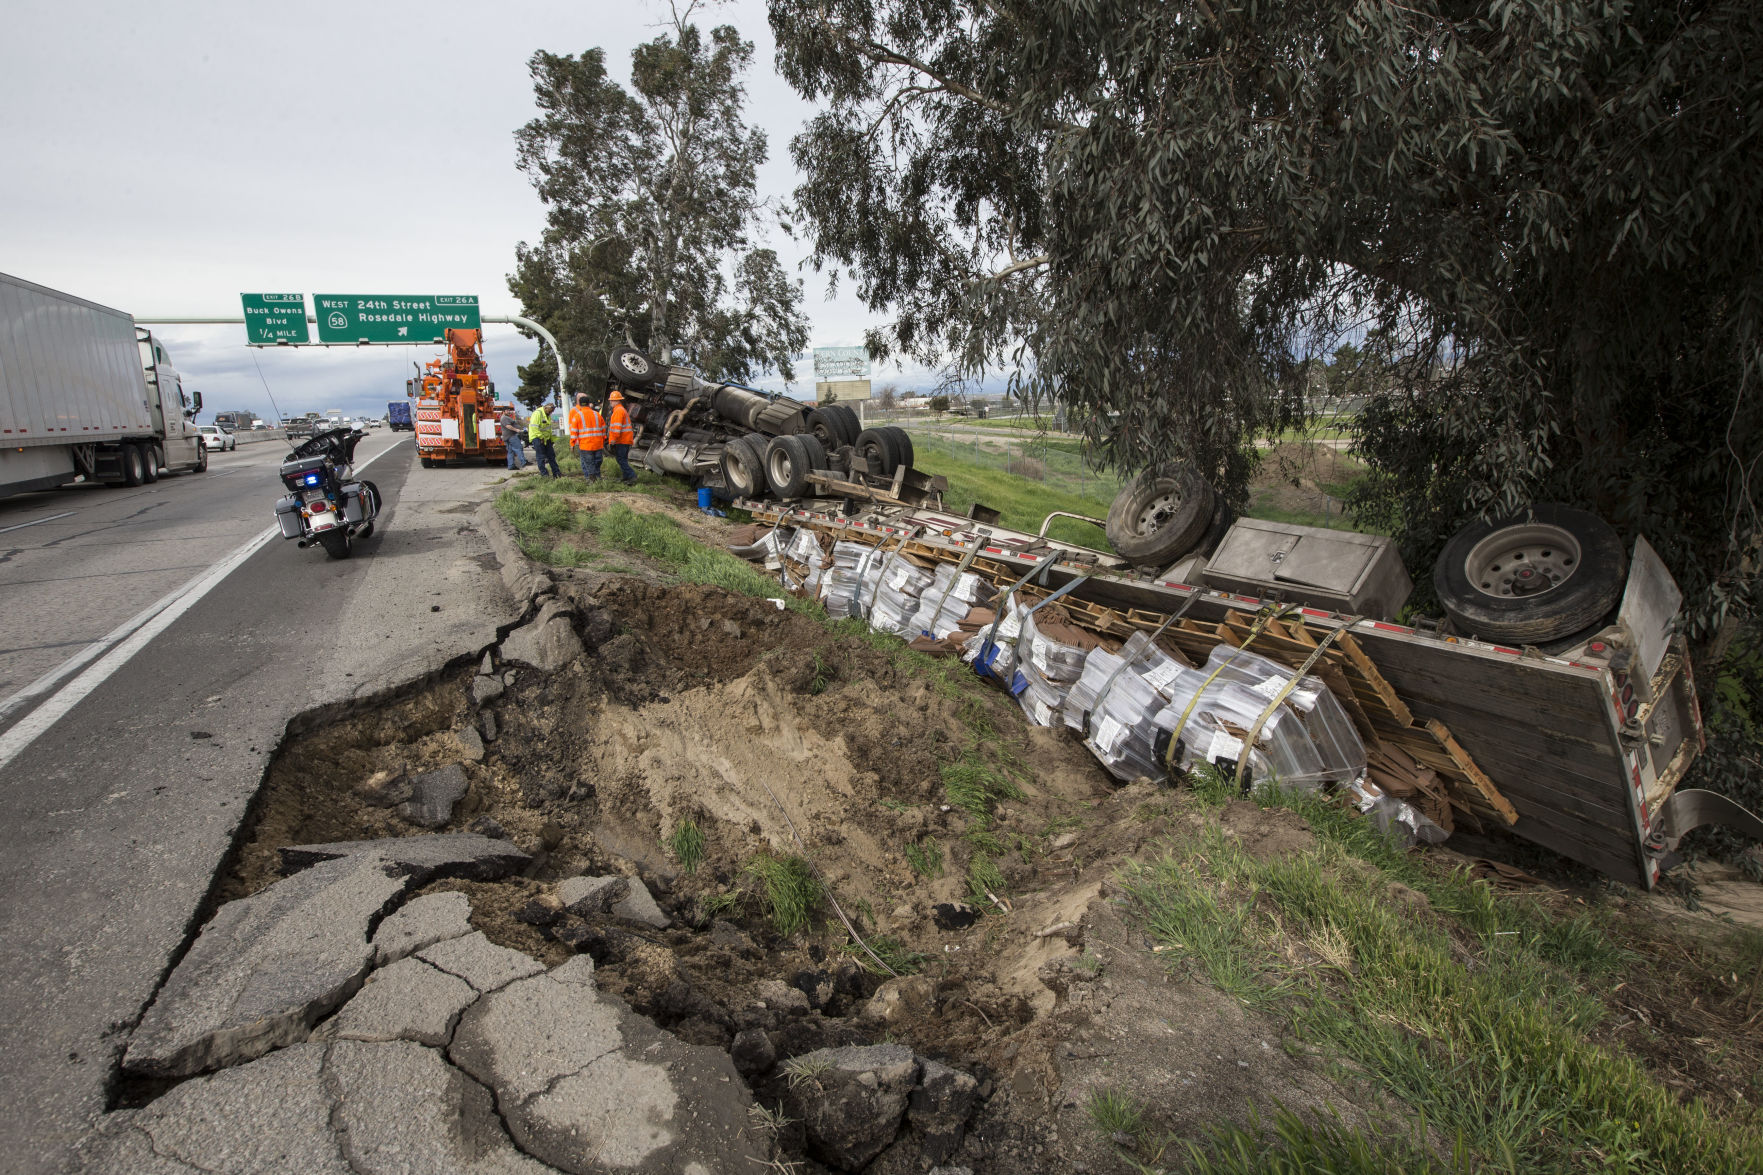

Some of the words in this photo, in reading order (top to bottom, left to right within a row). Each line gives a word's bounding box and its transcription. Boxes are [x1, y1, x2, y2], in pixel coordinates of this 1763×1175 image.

[322, 300, 349, 308] WEST
[357, 300, 387, 309] 24th
[393, 300, 430, 309] Street
[331, 317, 344, 325] 58
[359, 313, 413, 322] Rosedale
[418, 313, 468, 324] Highway
[259, 329, 273, 338] 1/4
